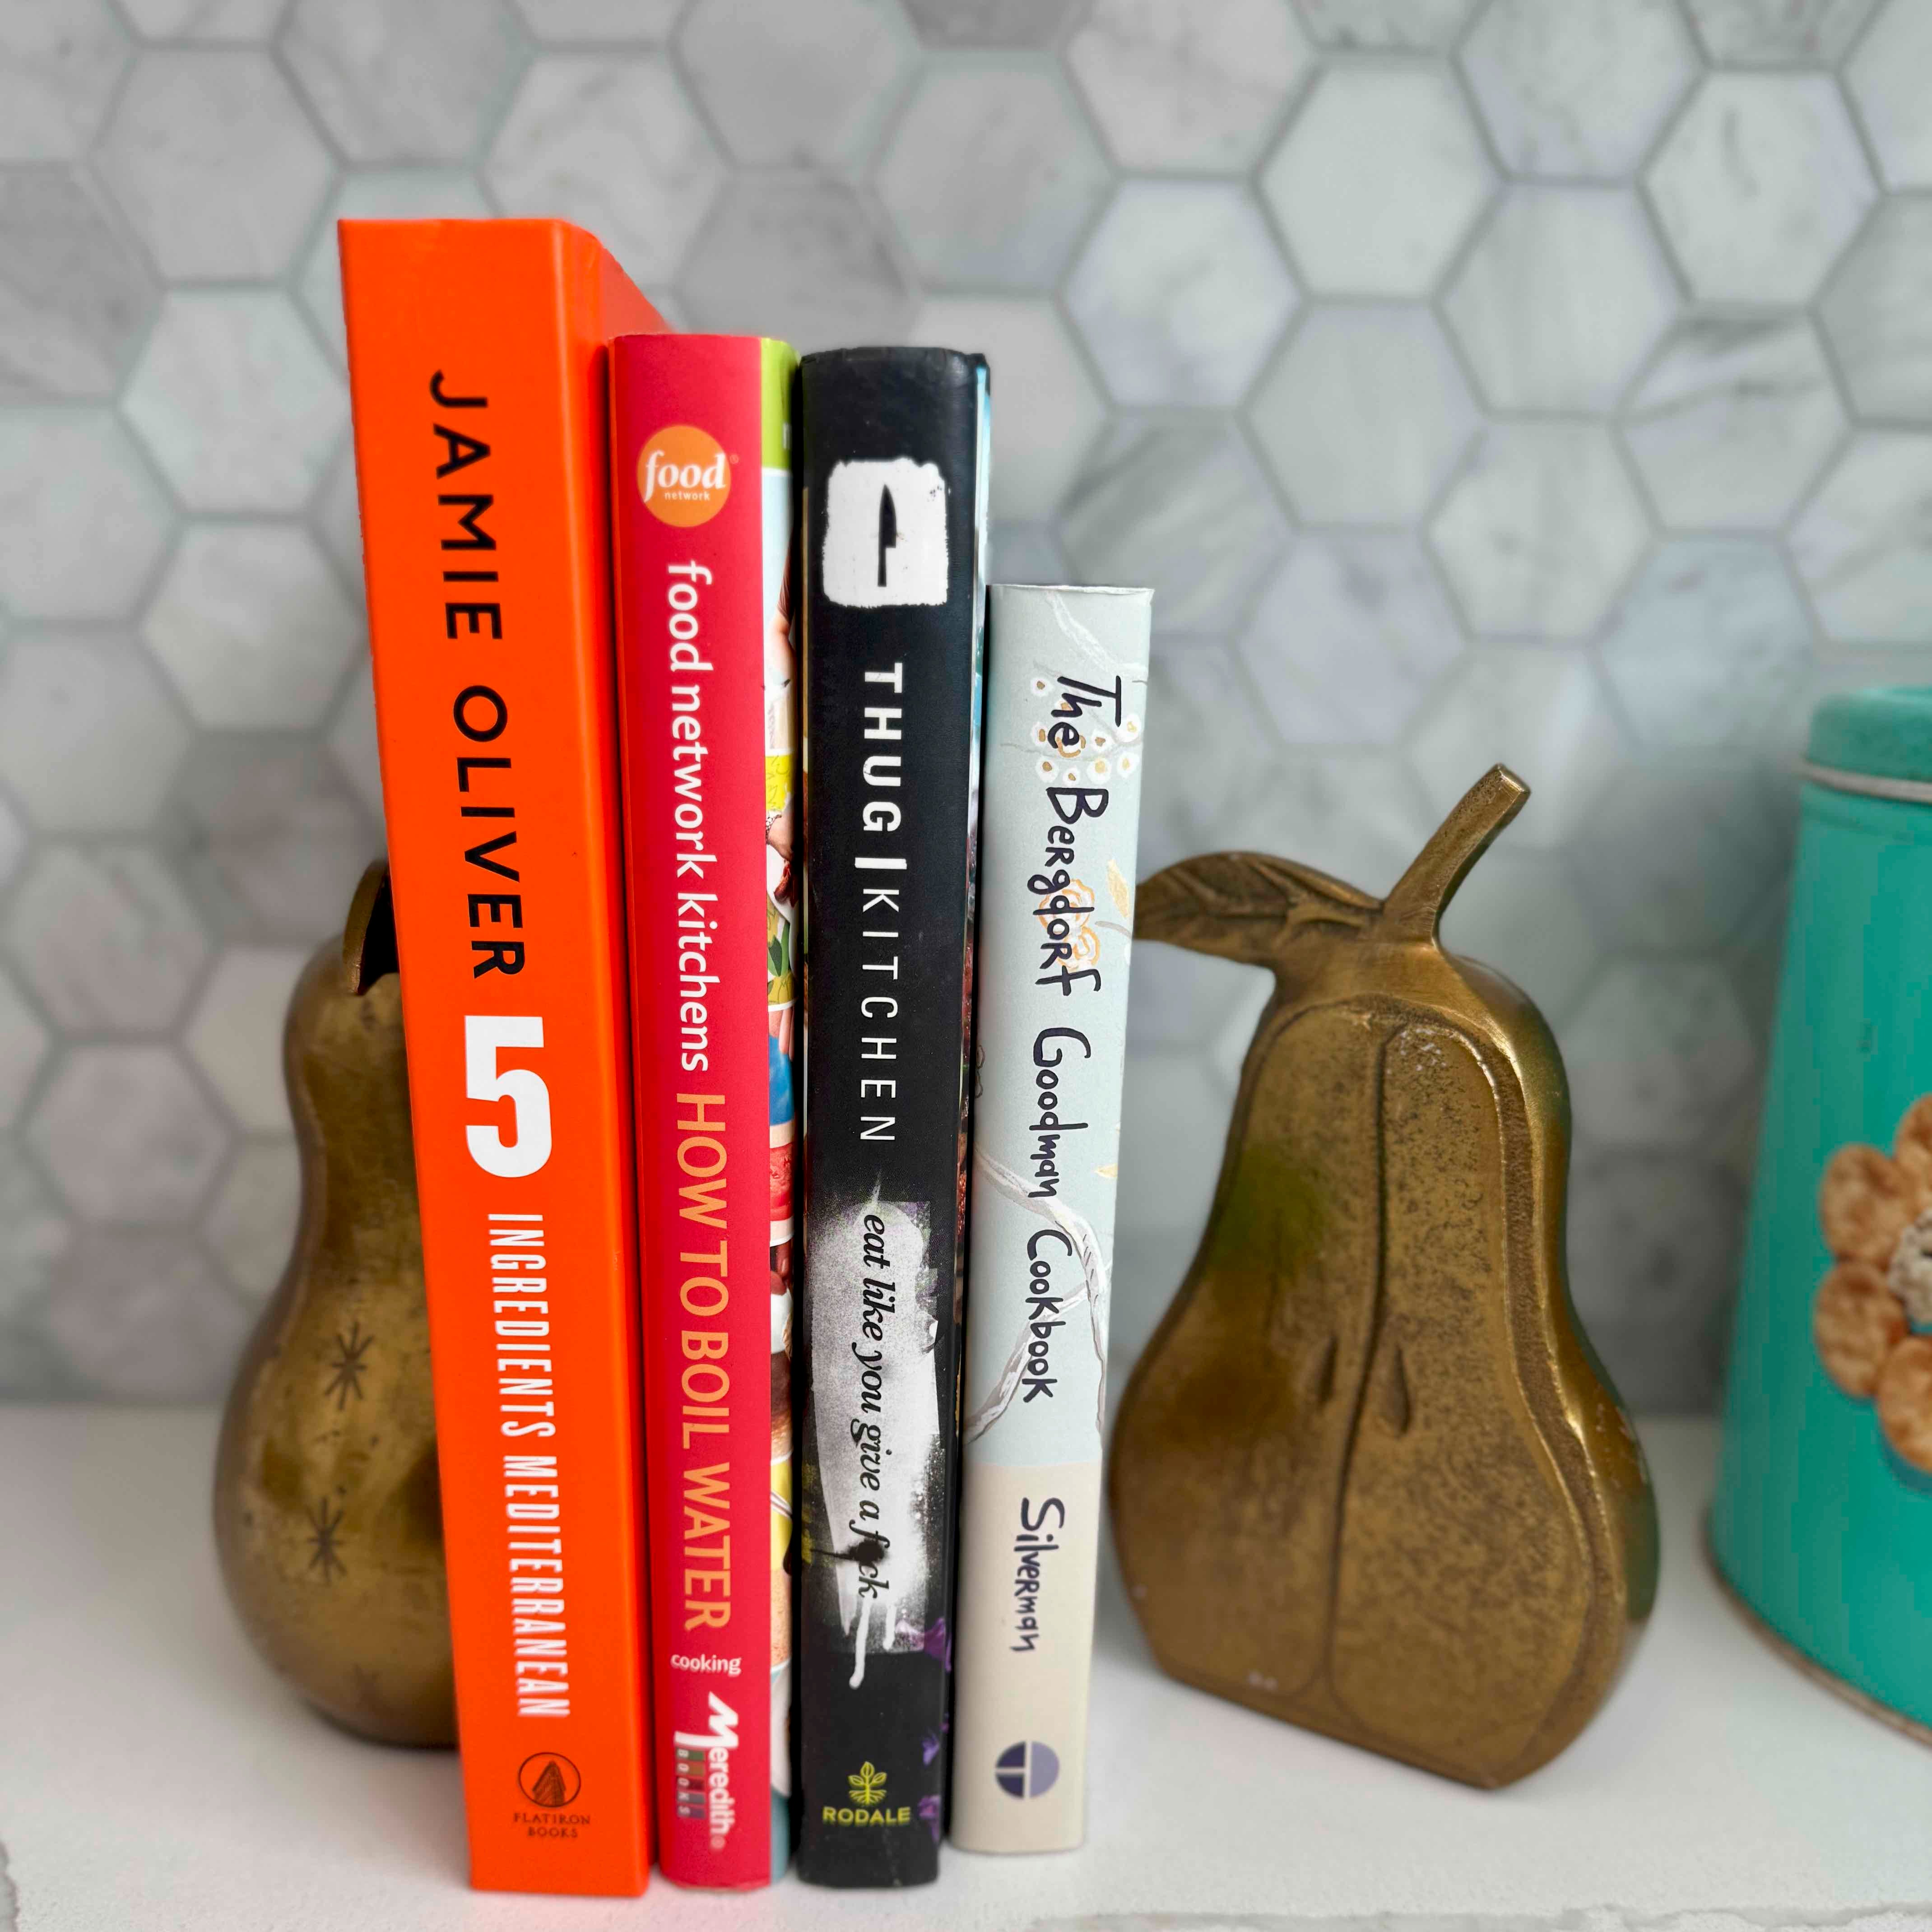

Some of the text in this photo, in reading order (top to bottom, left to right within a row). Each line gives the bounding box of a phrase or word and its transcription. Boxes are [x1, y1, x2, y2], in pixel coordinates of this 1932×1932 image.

[644, 450, 726, 503] food
[664, 490, 711, 501] network
[430, 369, 525, 979] JAMIE OLIVER
[1047, 675, 1122, 749] The
[860, 662, 903, 1141] THUG KITCHEN
[668, 560, 731, 1631] food network kitchens HOW TO BOIL WATER
[1028, 1027, 1091, 1198] Goodman
[464, 1015, 570, 1718] 5 INGREDIENTS MEDITERRANEAN
[1022, 1230, 1073, 1403] Cookbook
[849, 1214, 896, 1599] eat like you give a fck
[670, 1654, 742, 1677] cooking
[513, 1812, 590, 1825] FLATIRON
[527, 1826, 578, 1838] BOOKS
[822, 1807, 910, 1826] RODALE
